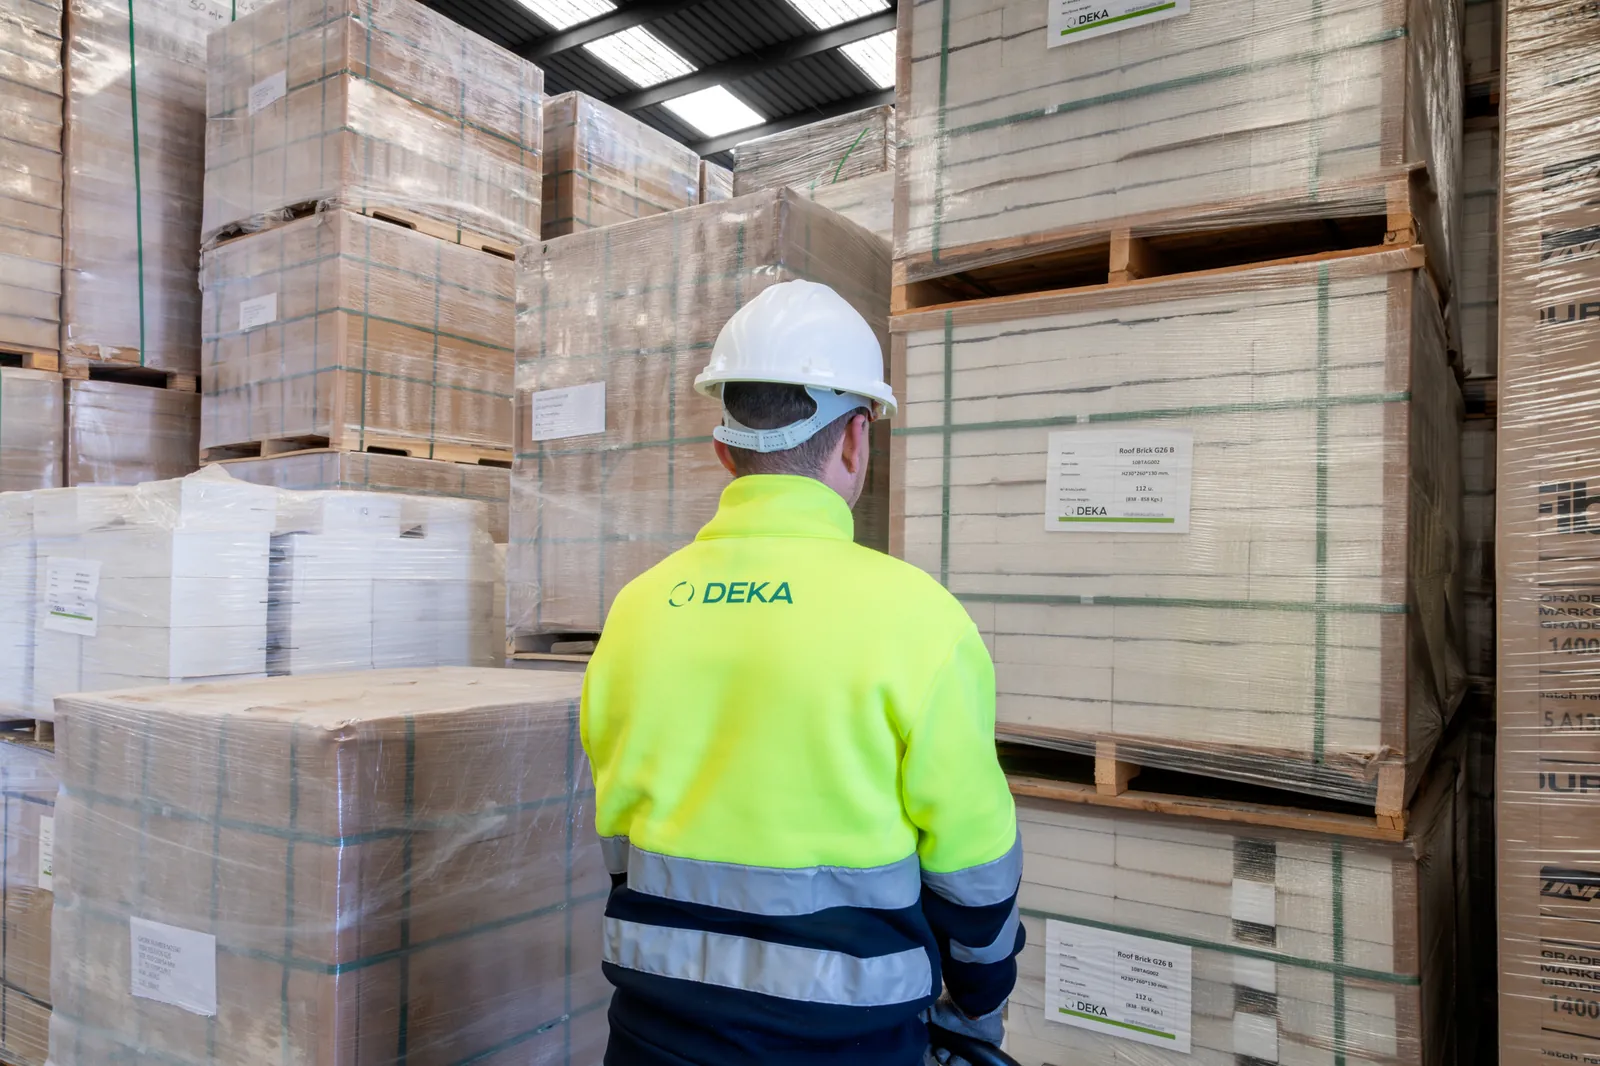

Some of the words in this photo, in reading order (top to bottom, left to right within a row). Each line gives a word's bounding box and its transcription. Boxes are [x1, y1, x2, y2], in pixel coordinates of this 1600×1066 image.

[1078, 9, 1109, 24] DEKA
[1154, 446, 1168, 454] G26
[1076, 506, 1108, 516] DEKA
[702, 581, 793, 604] DEKA
[1540, 594, 1600, 602] GRADE
[1540, 620, 1600, 629] GRADE
[1117, 951, 1133, 960] Roof
[1134, 954, 1152, 964] Brick
[1152, 958, 1167, 967] G26
[1541, 950, 1600, 966] GRADE
[1135, 993, 1147, 1001] 112
[1077, 1001, 1108, 1017] DEKA
